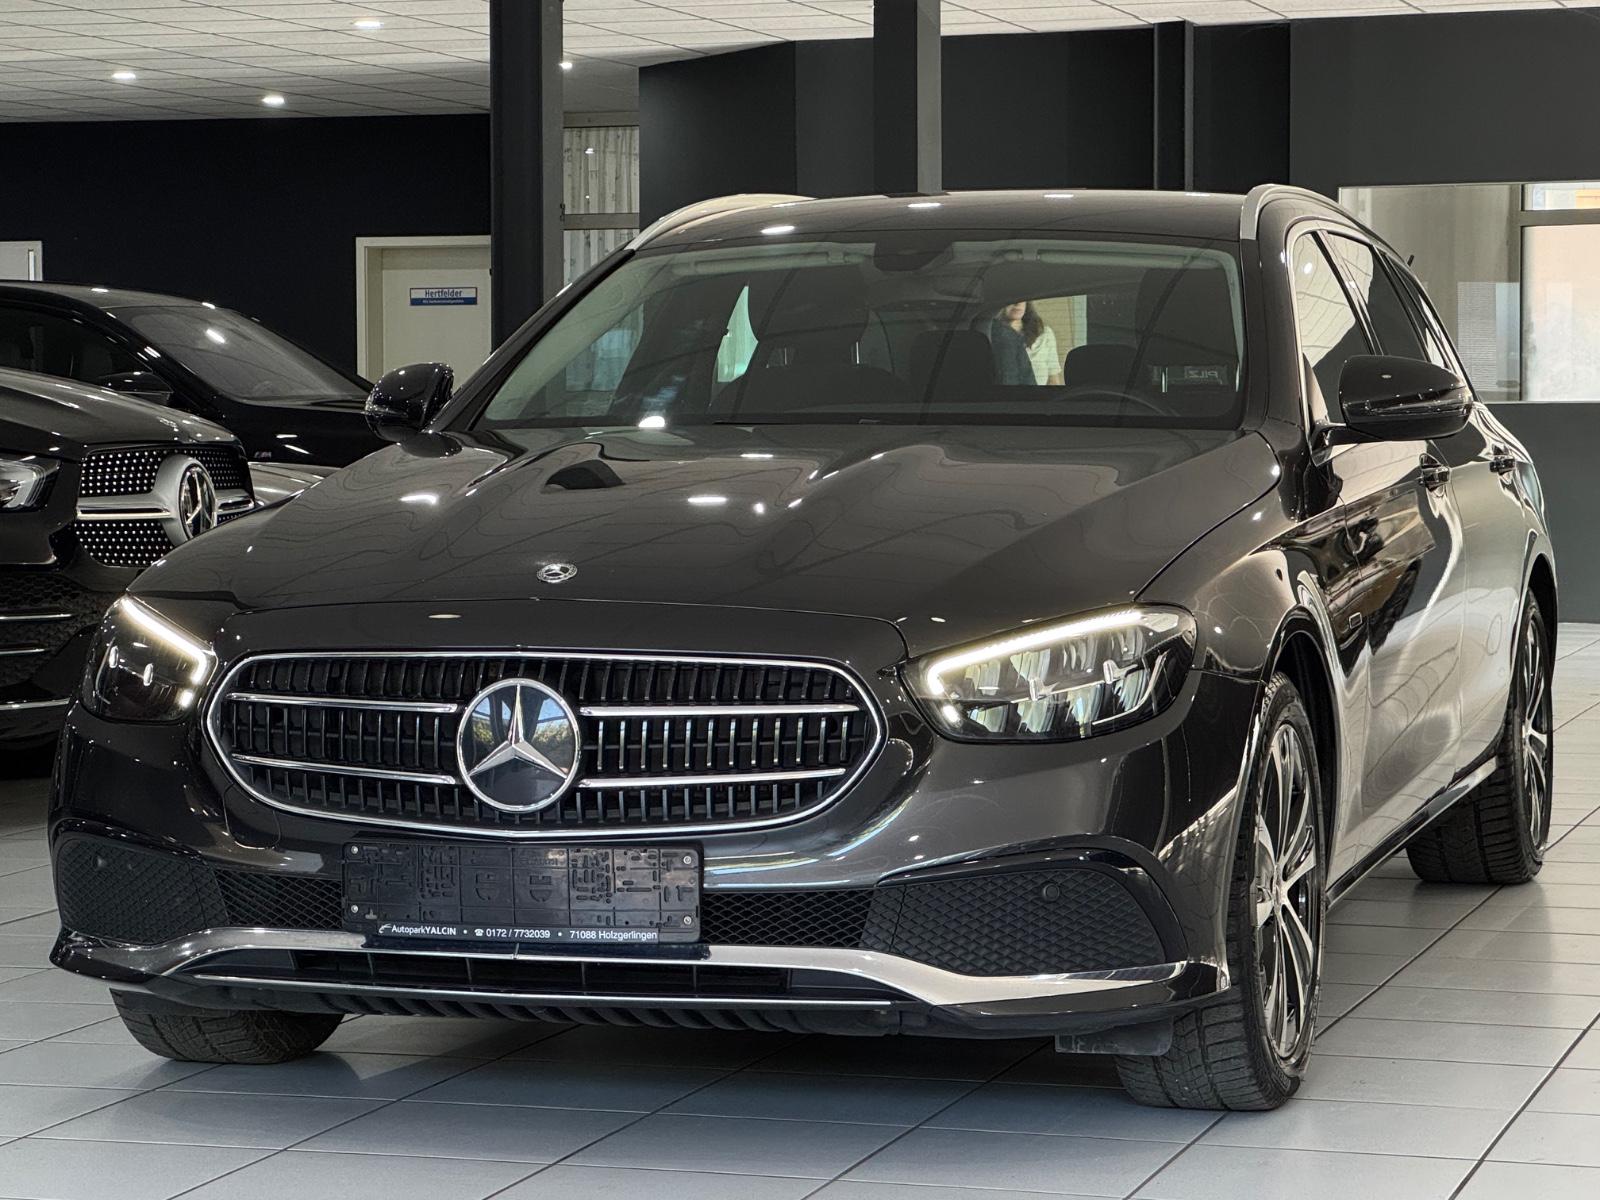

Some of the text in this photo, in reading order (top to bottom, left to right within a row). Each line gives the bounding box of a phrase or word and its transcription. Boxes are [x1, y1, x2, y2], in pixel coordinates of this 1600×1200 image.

[425, 289, 463, 298] Hertfelder
[391, 925, 457, 936] AutoparkYALCIN
[486, 929, 507, 938] 0172
[514, 929, 551, 939] 7732039
[569, 930, 597, 940] 71088
[598, 930, 658, 942] Holzgerlingen
